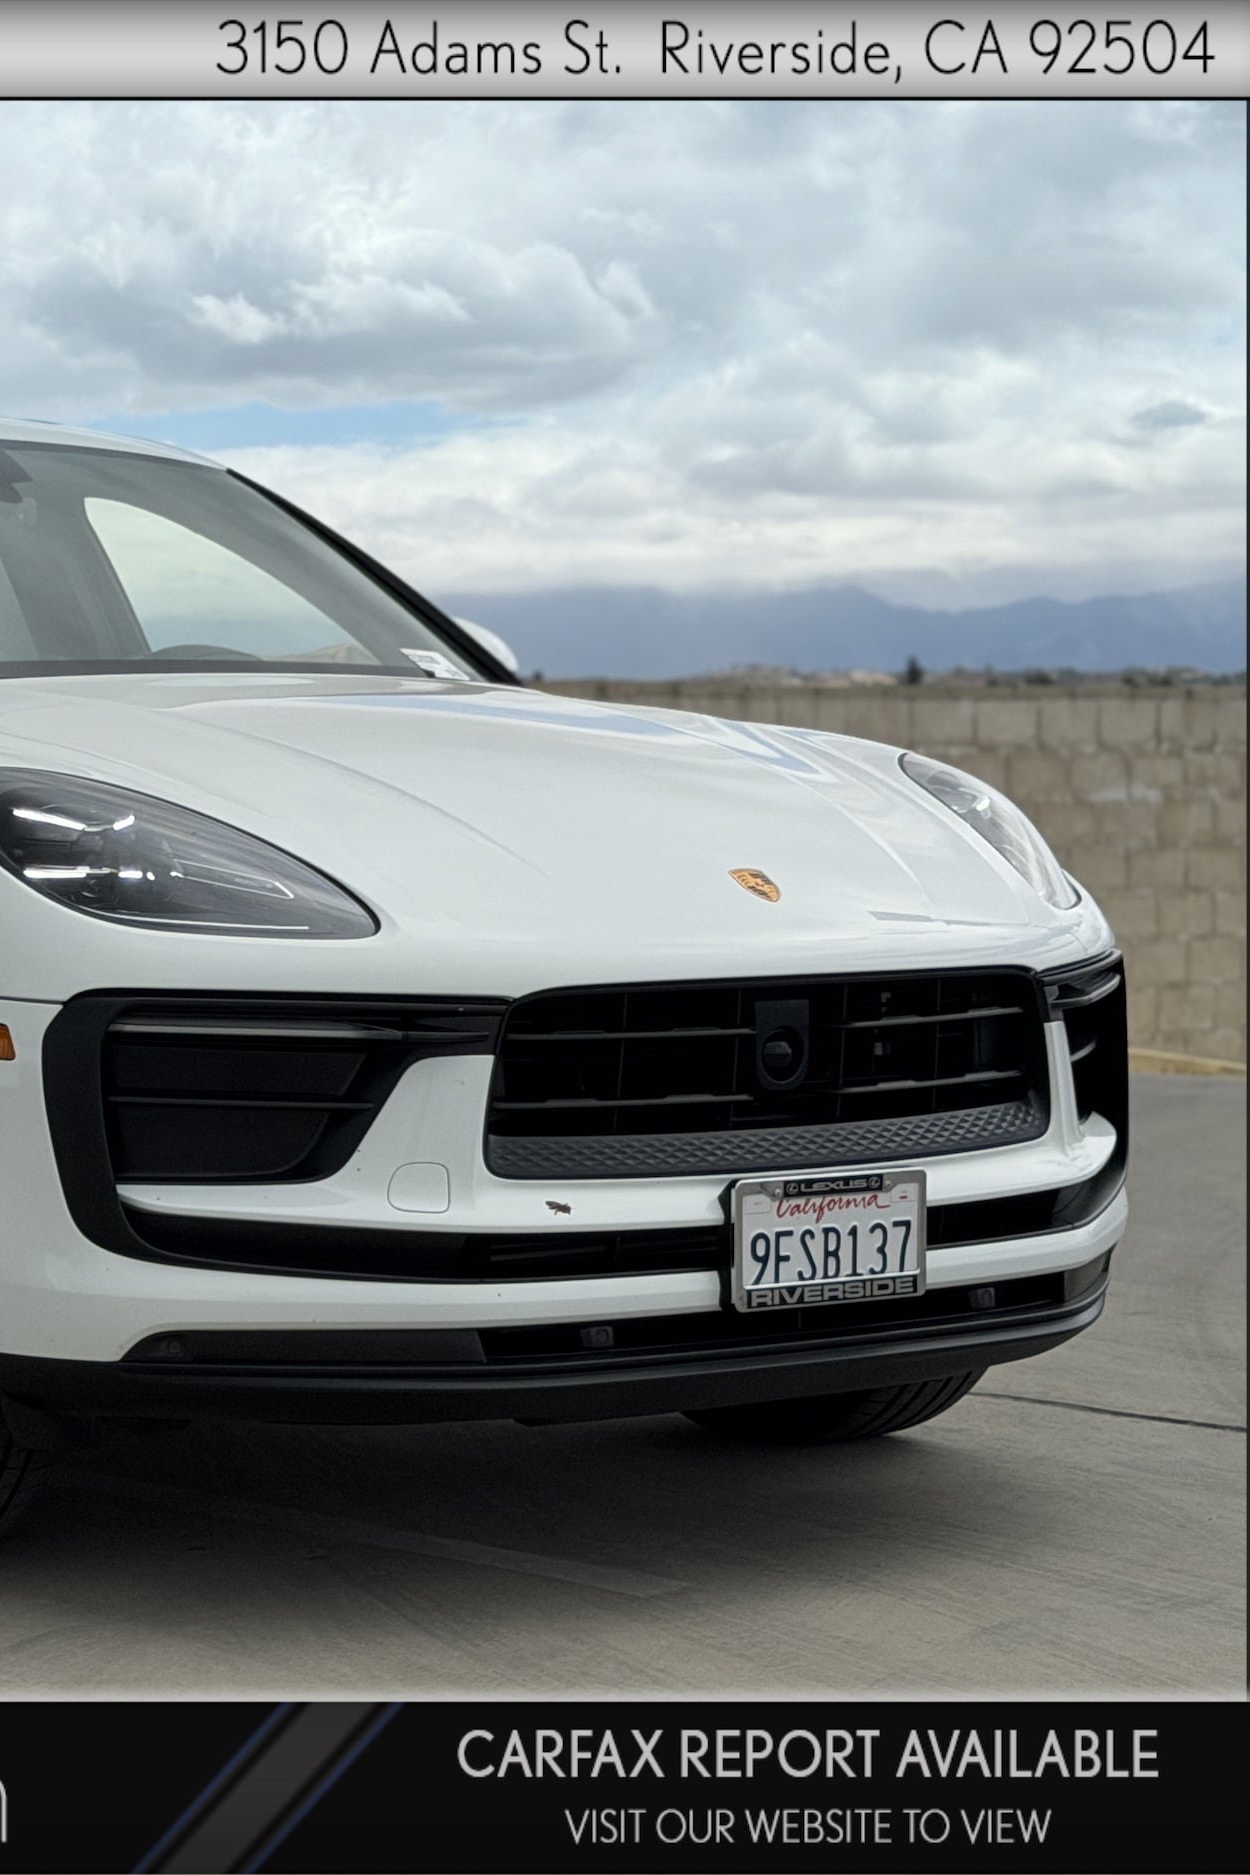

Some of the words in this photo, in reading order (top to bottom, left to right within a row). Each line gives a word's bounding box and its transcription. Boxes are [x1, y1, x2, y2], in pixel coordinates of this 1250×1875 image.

[800, 1178, 867, 1193] LEXUS
[776, 1194, 891, 1224] California
[750, 1219, 912, 1286] 9FSB137
[751, 1276, 915, 1308] RIVERSIDE
